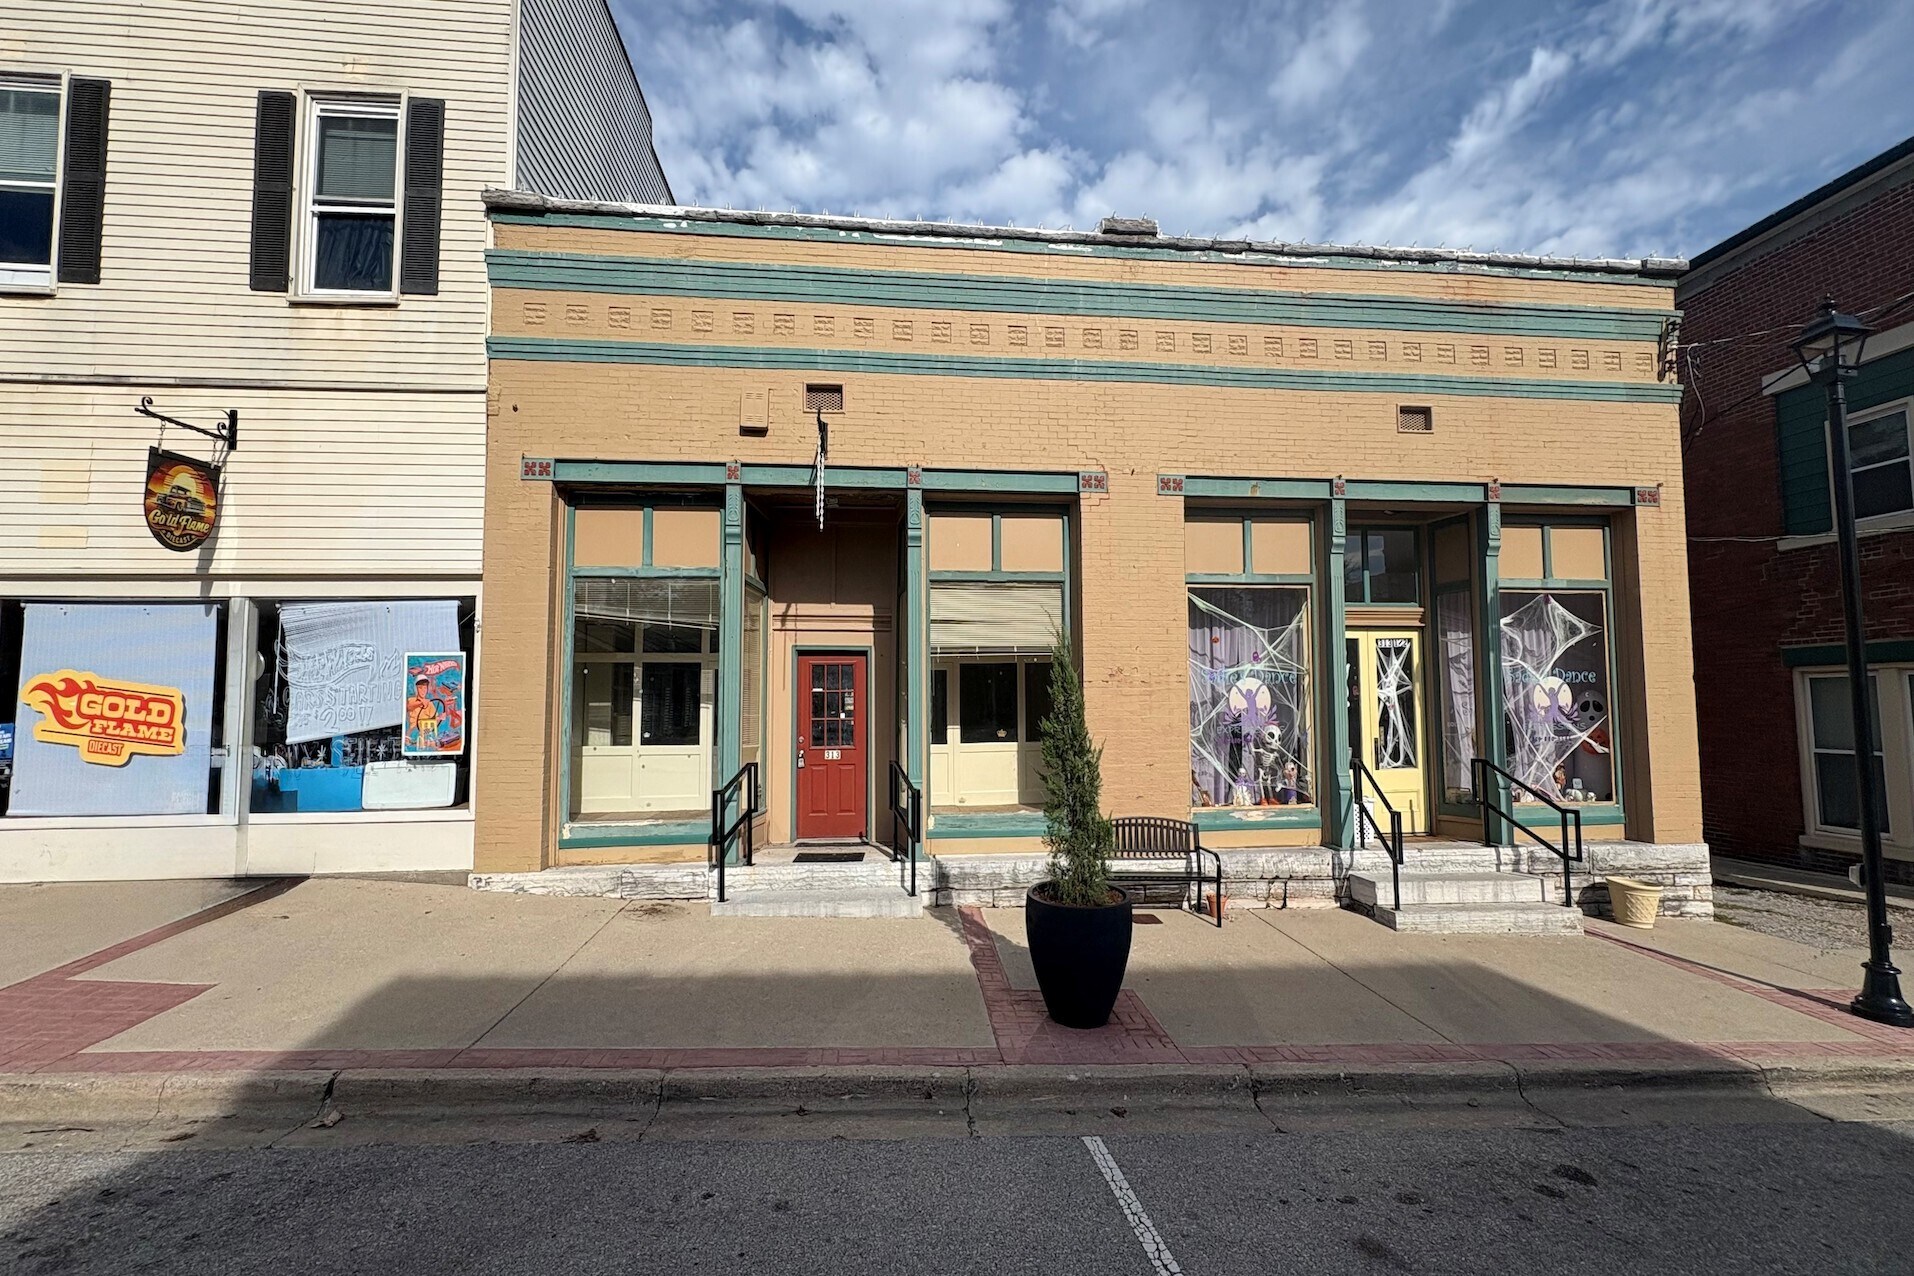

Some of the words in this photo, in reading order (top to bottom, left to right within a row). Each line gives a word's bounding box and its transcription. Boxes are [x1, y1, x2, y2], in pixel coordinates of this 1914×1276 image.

[149, 509, 180, 527] Gold
[174, 515, 210, 536] Flame
[166, 532, 190, 543] DIECAST
[1552, 667, 1597, 683] Dance
[79, 692, 172, 726] GOLD
[91, 719, 175, 742] FLAME
[88, 740, 124, 756] DIECAST
[825, 750, 841, 760] 313
